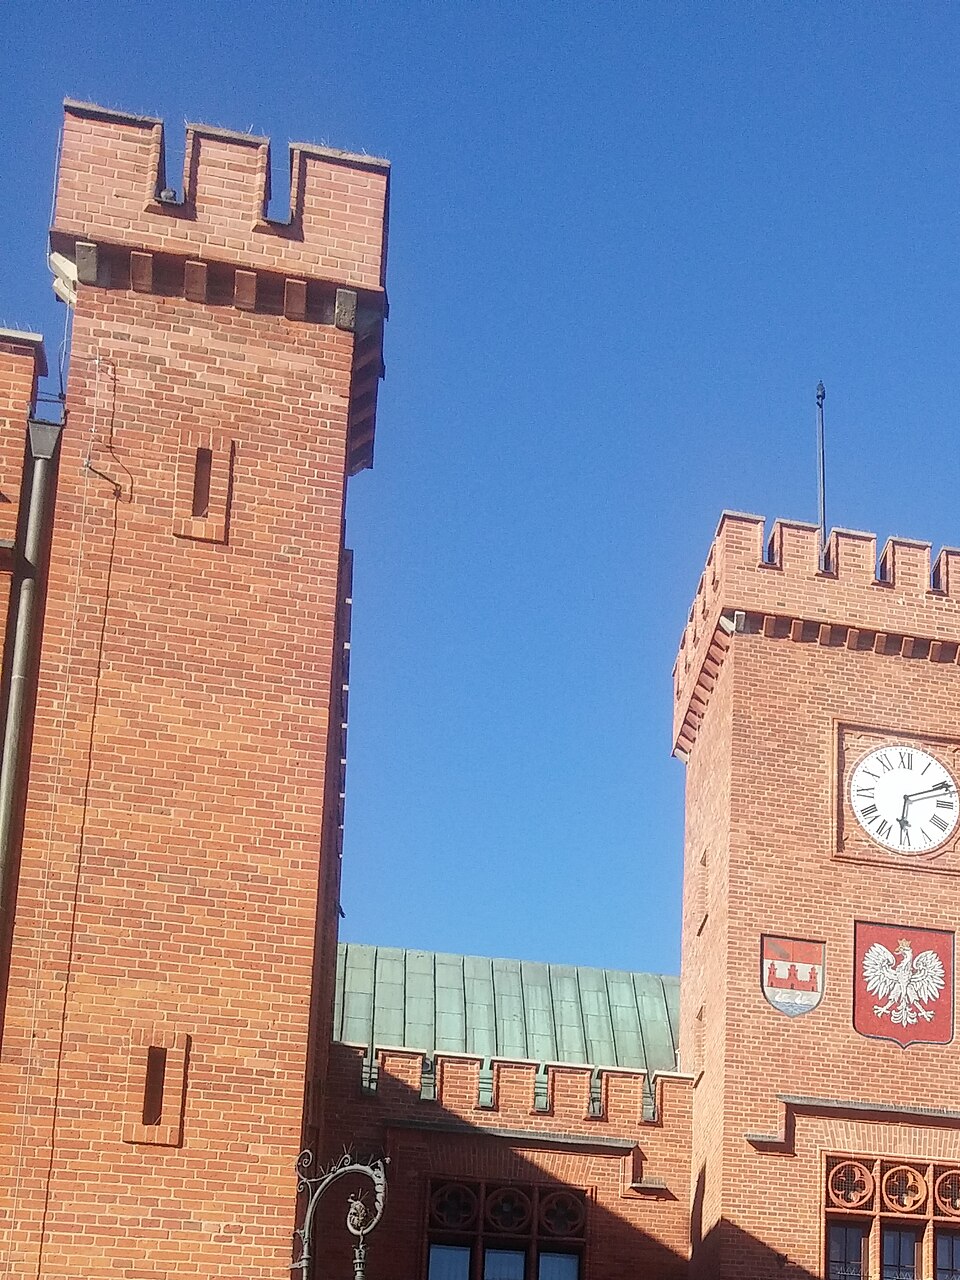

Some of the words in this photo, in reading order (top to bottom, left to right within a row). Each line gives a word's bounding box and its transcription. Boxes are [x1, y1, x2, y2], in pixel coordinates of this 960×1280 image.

[898, 751, 913, 770] XII
[860, 804, 881, 824] VIII
[936, 800, 953, 810] III
[876, 819, 893, 840] VII
